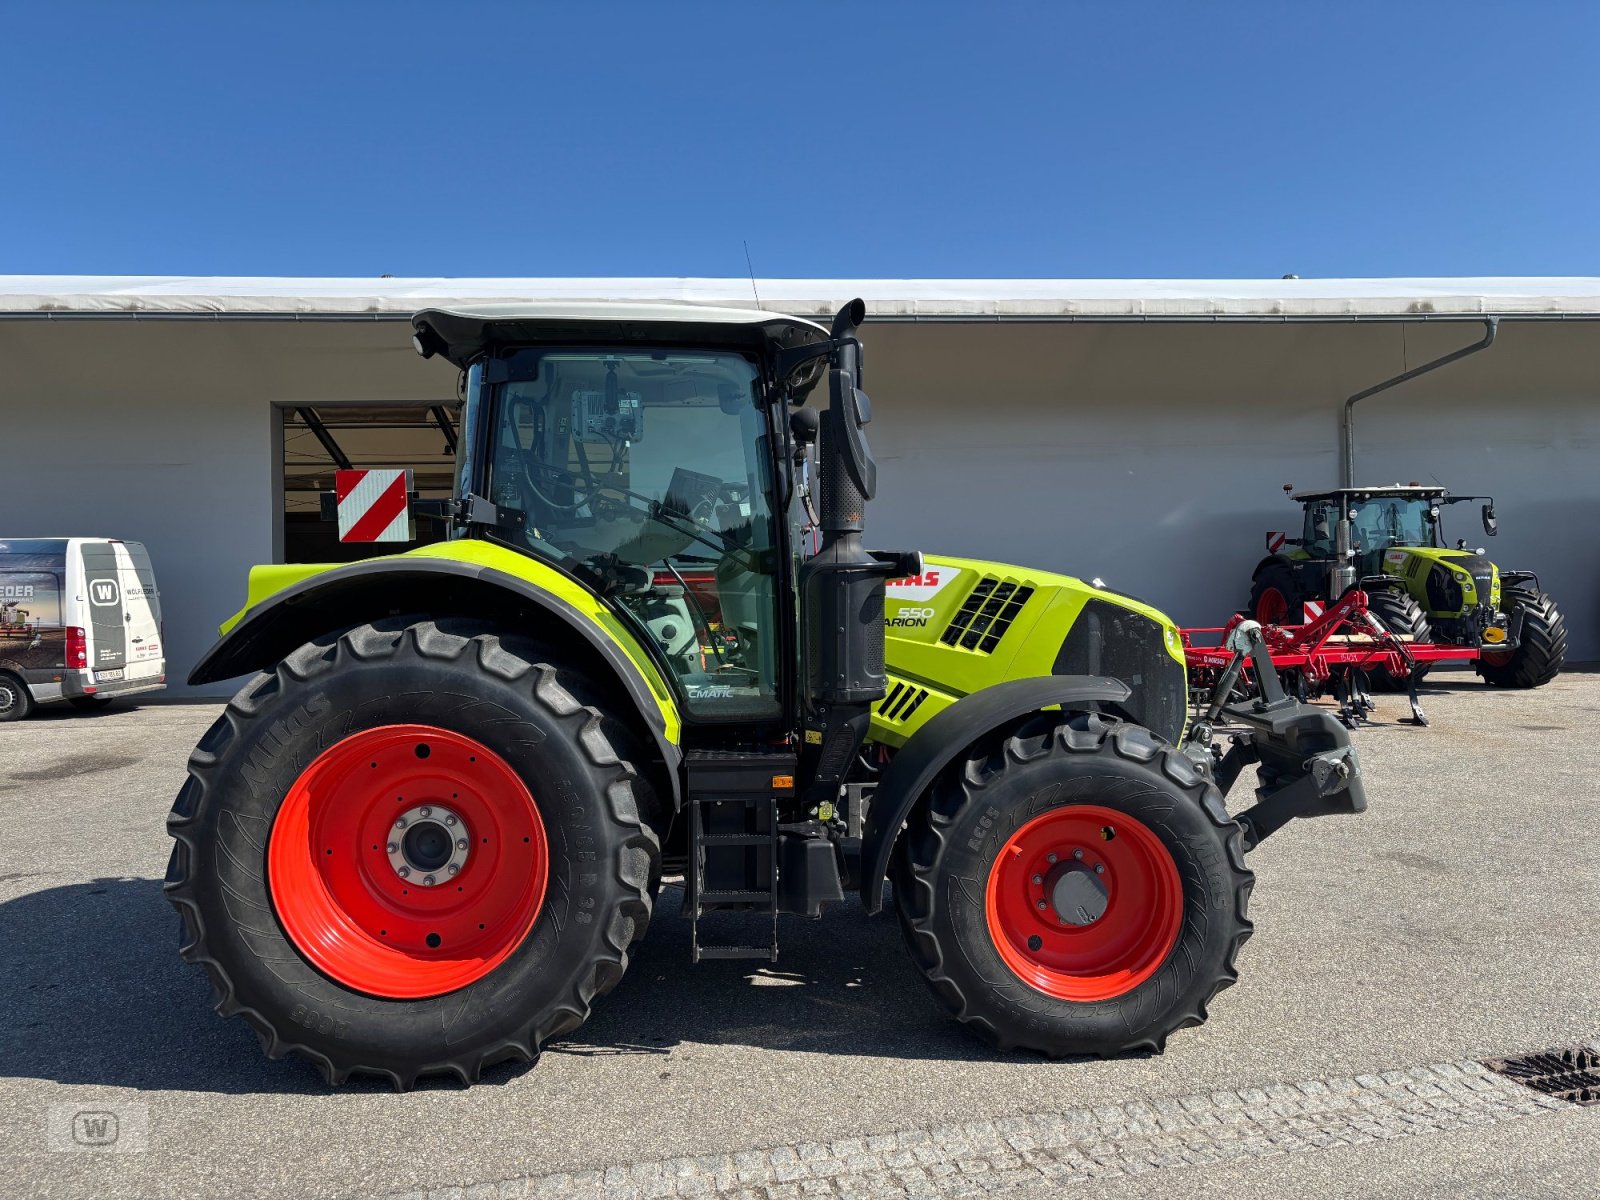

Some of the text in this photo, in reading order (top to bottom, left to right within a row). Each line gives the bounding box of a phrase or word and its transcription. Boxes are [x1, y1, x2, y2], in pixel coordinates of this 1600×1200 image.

[885, 572, 939, 586] AAS
[897, 607, 935, 618] 550
[884, 617, 927, 627] ARION
[688, 689, 734, 699] CMATIC
